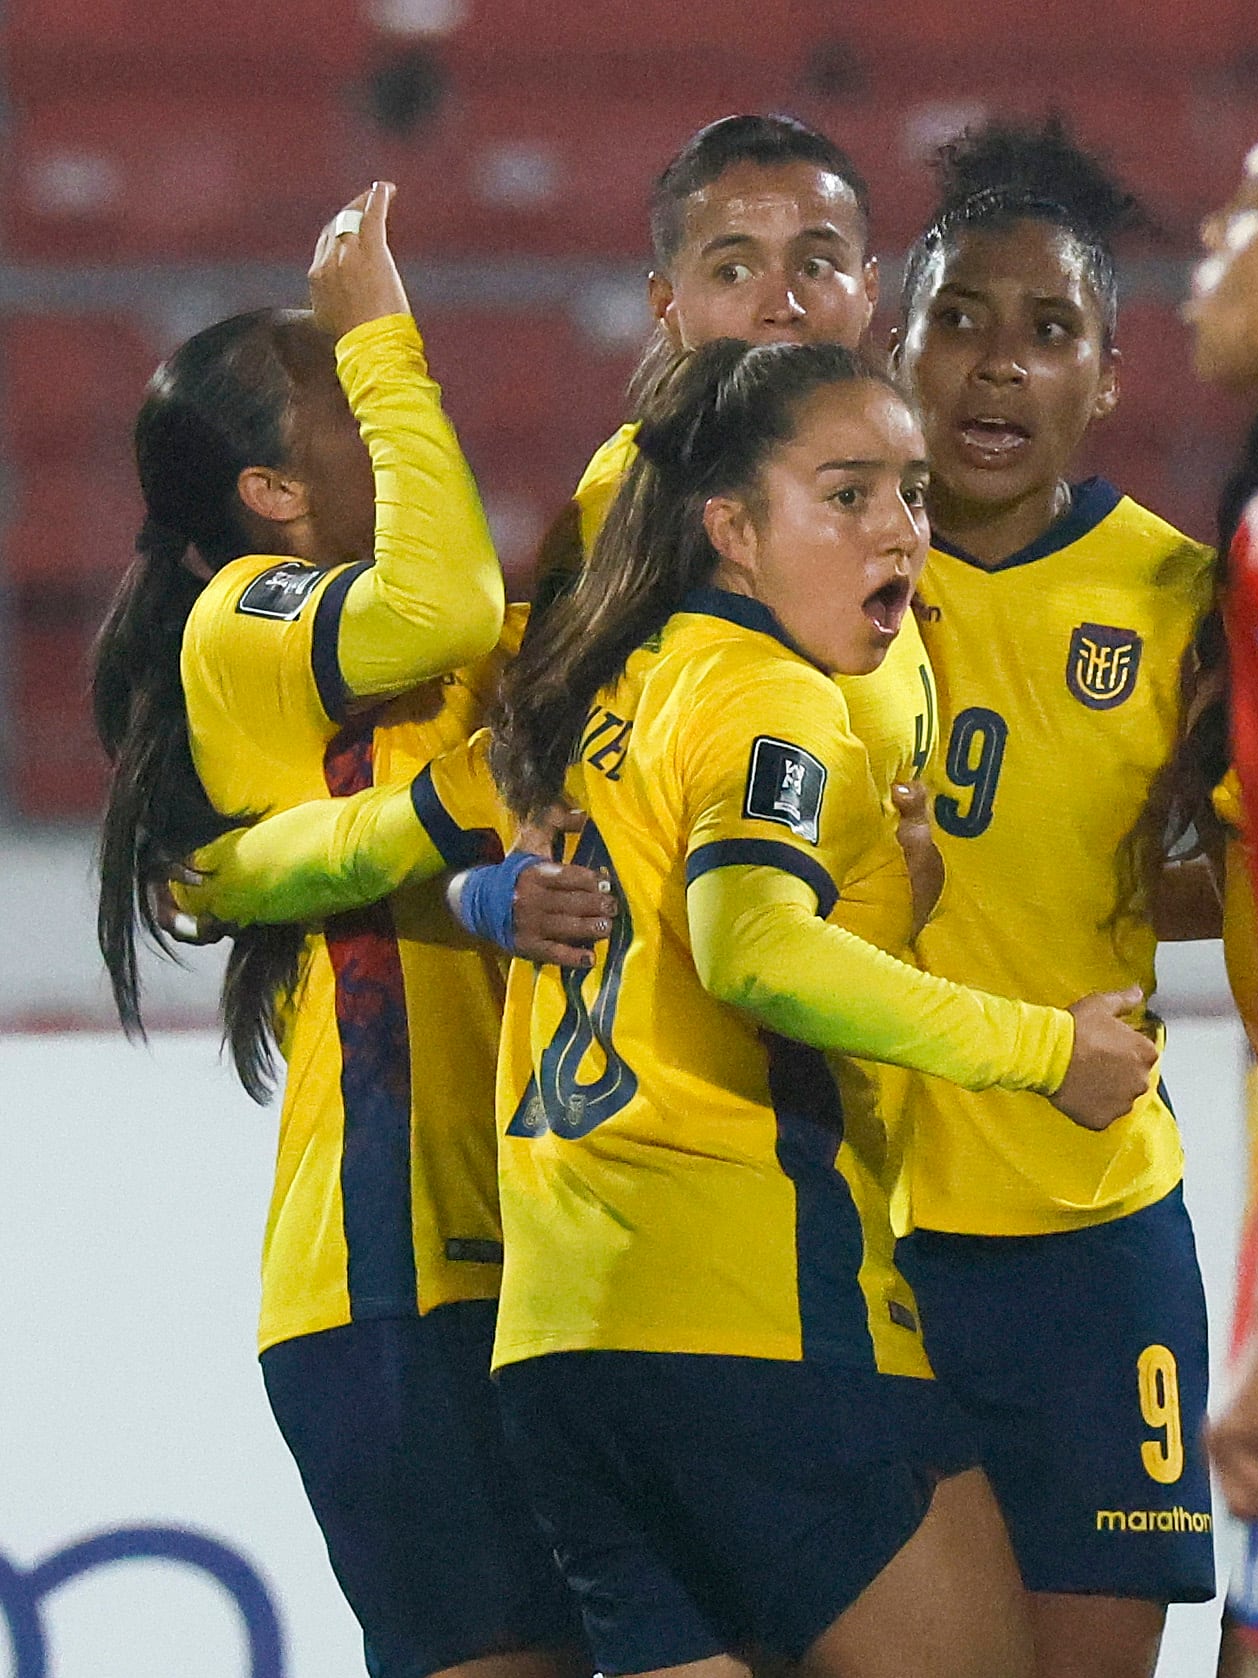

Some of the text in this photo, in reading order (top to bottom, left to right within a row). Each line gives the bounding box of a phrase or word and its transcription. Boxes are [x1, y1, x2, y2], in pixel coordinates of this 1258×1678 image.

[934, 706, 1009, 838] 9
[1136, 1344, 1183, 1484] 9
[1096, 1505, 1212, 1533] marathon
